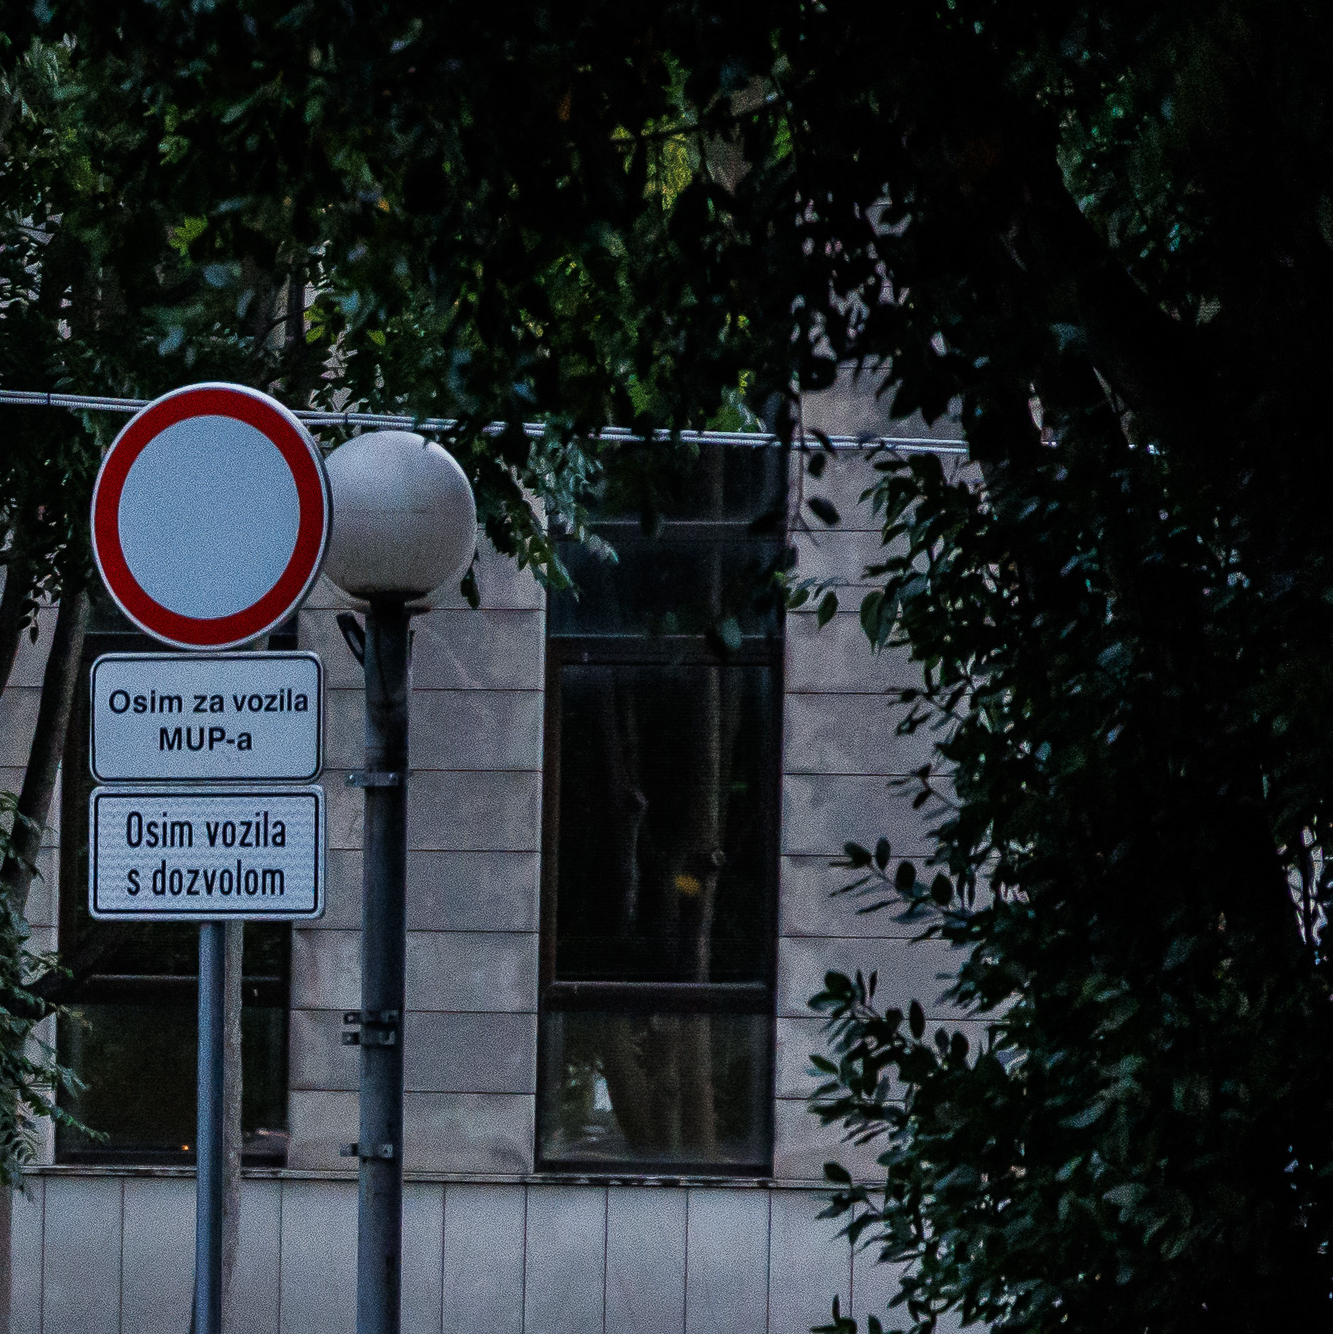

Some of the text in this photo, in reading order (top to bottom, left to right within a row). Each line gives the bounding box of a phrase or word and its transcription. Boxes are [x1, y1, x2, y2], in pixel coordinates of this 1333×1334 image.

[108, 688, 308, 714] Osim za vozila
[159, 726, 252, 752] MUP-a
[126, 810, 286, 849] Osim vozila
[126, 859, 285, 897] s dozvolom
